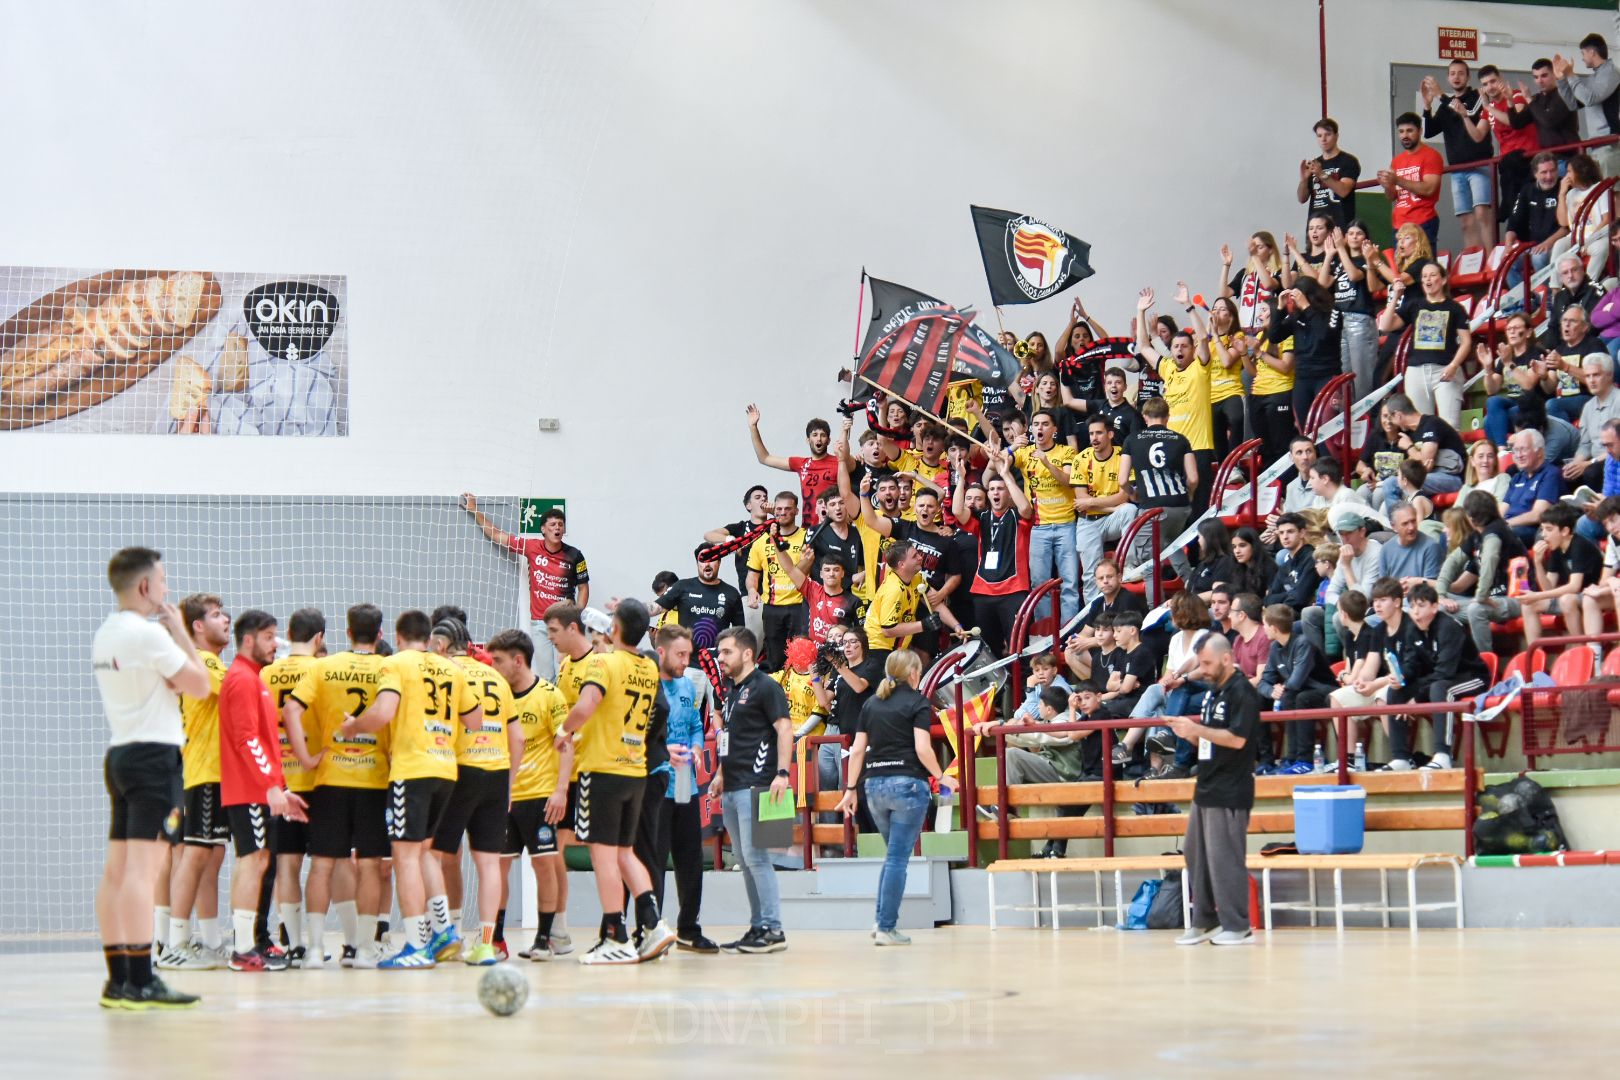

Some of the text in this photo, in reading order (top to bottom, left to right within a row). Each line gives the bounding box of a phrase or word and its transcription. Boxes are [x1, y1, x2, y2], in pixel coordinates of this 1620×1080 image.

[1439, 29, 1476, 39] IRTEERARIK
[1449, 40, 1467, 48] GABE
[1441, 49, 1475, 59] SIN SALIDA
[1149, 441, 1166, 468] 6
[1026, 458, 1039, 470] 77
[806, 473, 820, 487] 29
[764, 545, 776, 557] 55
[535, 555, 549, 567] 66
[270, 672, 307, 686] DOM
[345, 686, 370, 723] 2
[423, 676, 453, 721] 31
[623, 688, 653, 731] 73
